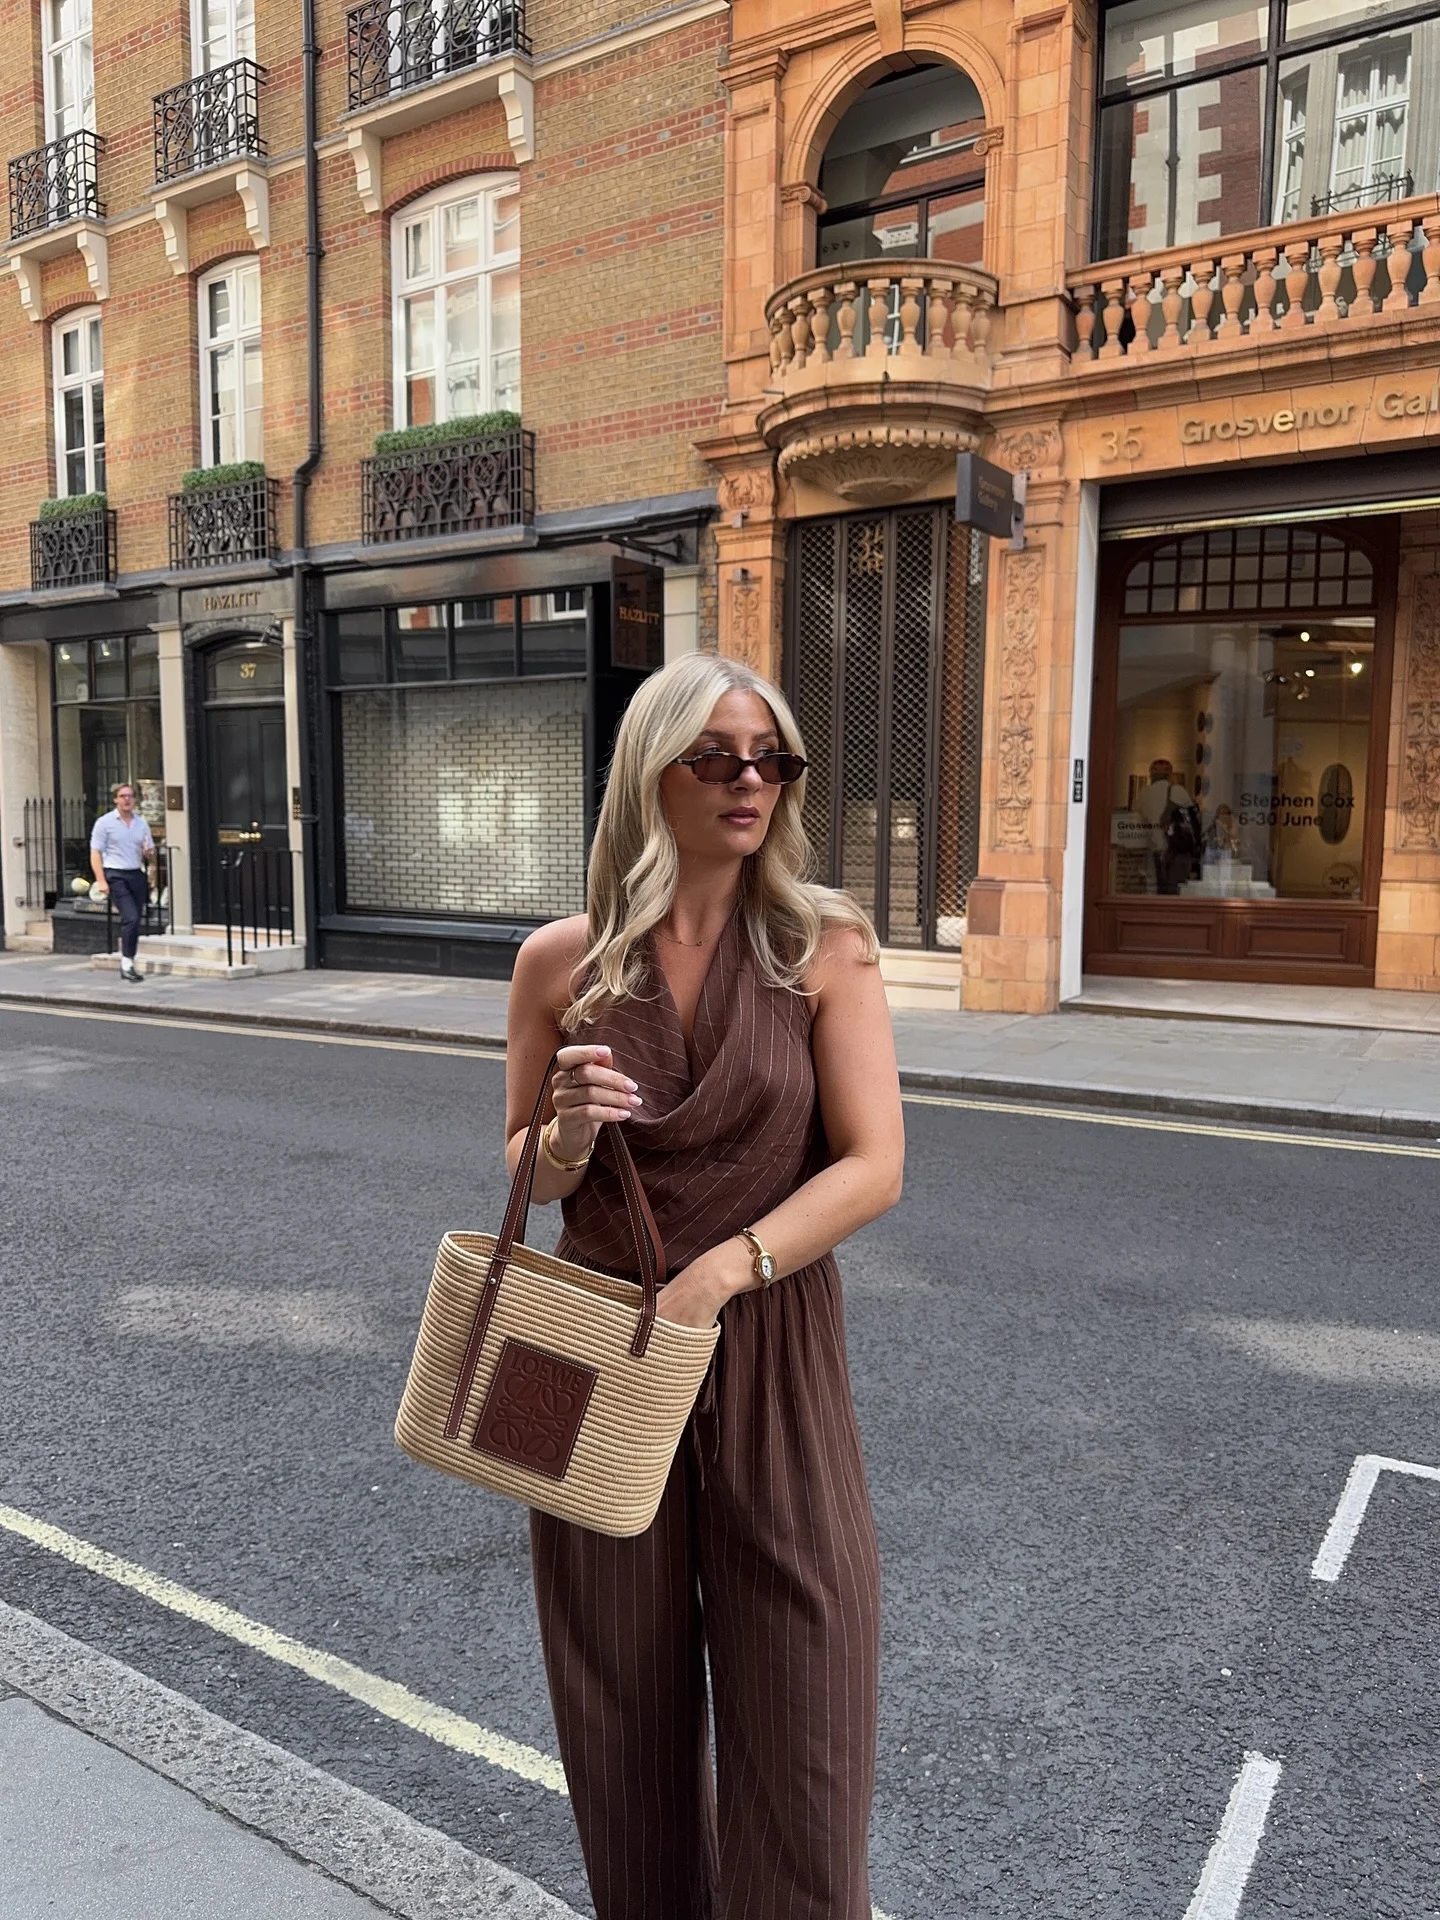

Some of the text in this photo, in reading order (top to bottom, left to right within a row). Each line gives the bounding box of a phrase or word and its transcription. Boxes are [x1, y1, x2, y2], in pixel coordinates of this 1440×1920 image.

[1100, 425, 1143, 464] 35
[1179, 402, 1354, 445] Grosvenor
[204, 591, 261, 611] HAZLITT
[619, 606, 660, 625] HAZLITT
[240, 663, 257, 679] 37
[1240, 792, 1355, 809] Stephen Cox
[1239, 811, 1277, 826] 6-30
[507, 1350, 585, 1395] LOEWE
